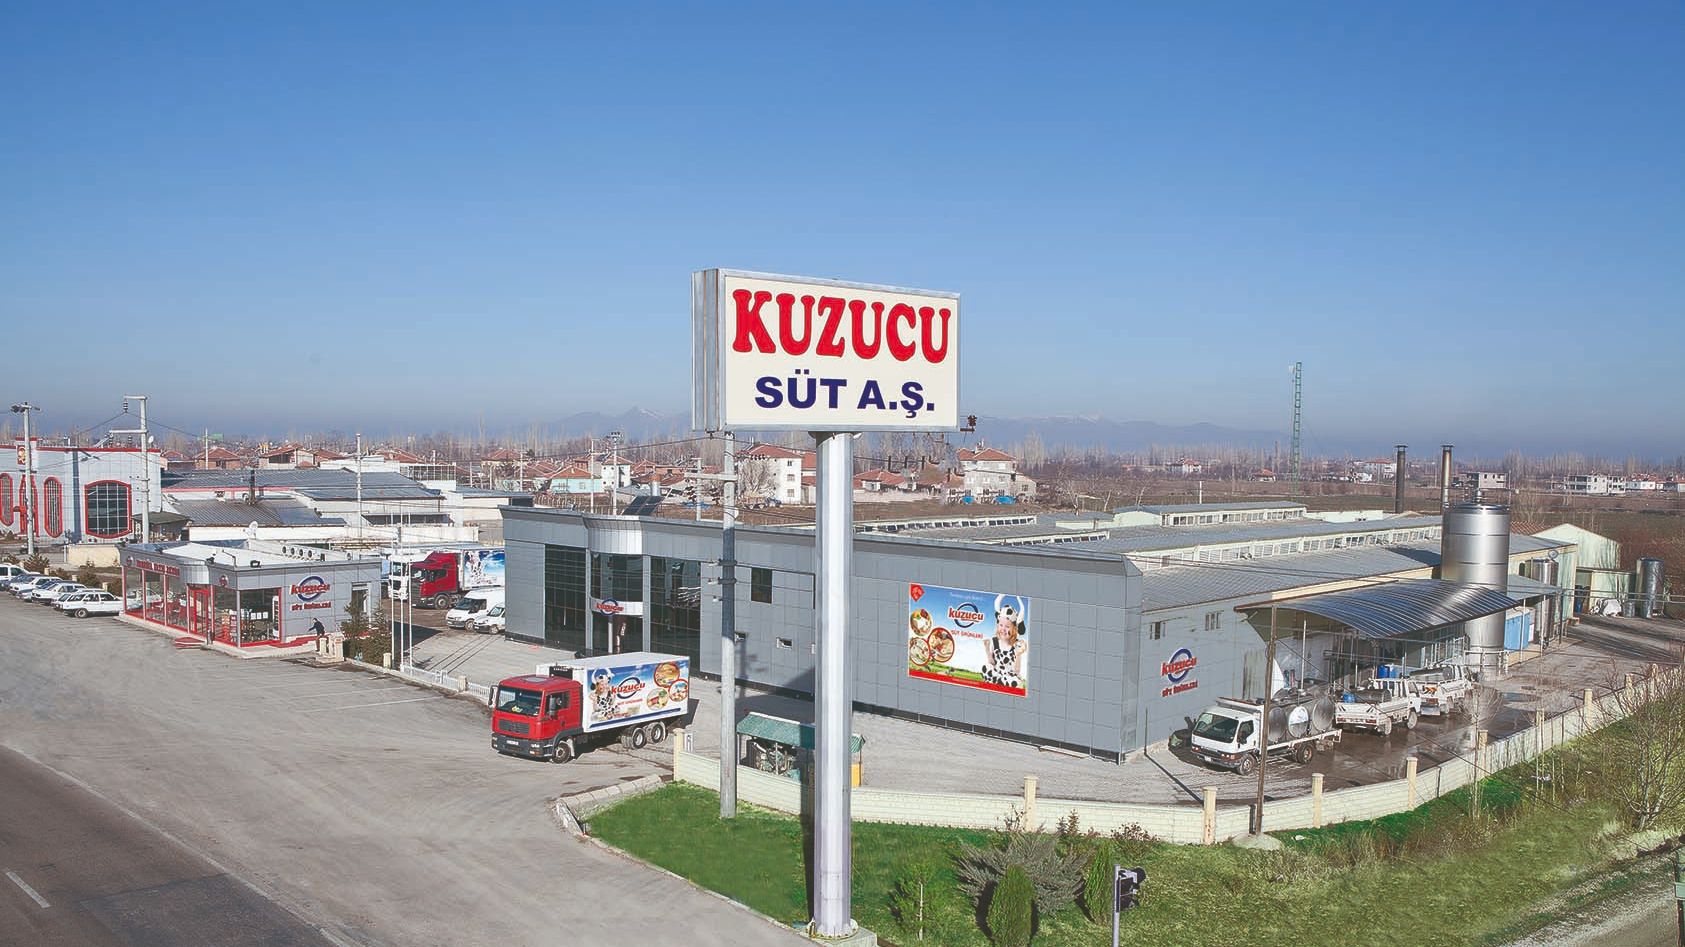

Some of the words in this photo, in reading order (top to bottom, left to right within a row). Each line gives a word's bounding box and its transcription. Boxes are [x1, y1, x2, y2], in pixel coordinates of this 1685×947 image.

[732, 289, 951, 363] KUZUCU
[754, 368, 848, 409] SÜT
[857, 379, 935, 418] A.Ş.
[948, 607, 984, 622] kuzucu
[1161, 656, 1197, 676] kuzucu
[611, 682, 646, 695] kuzucu
